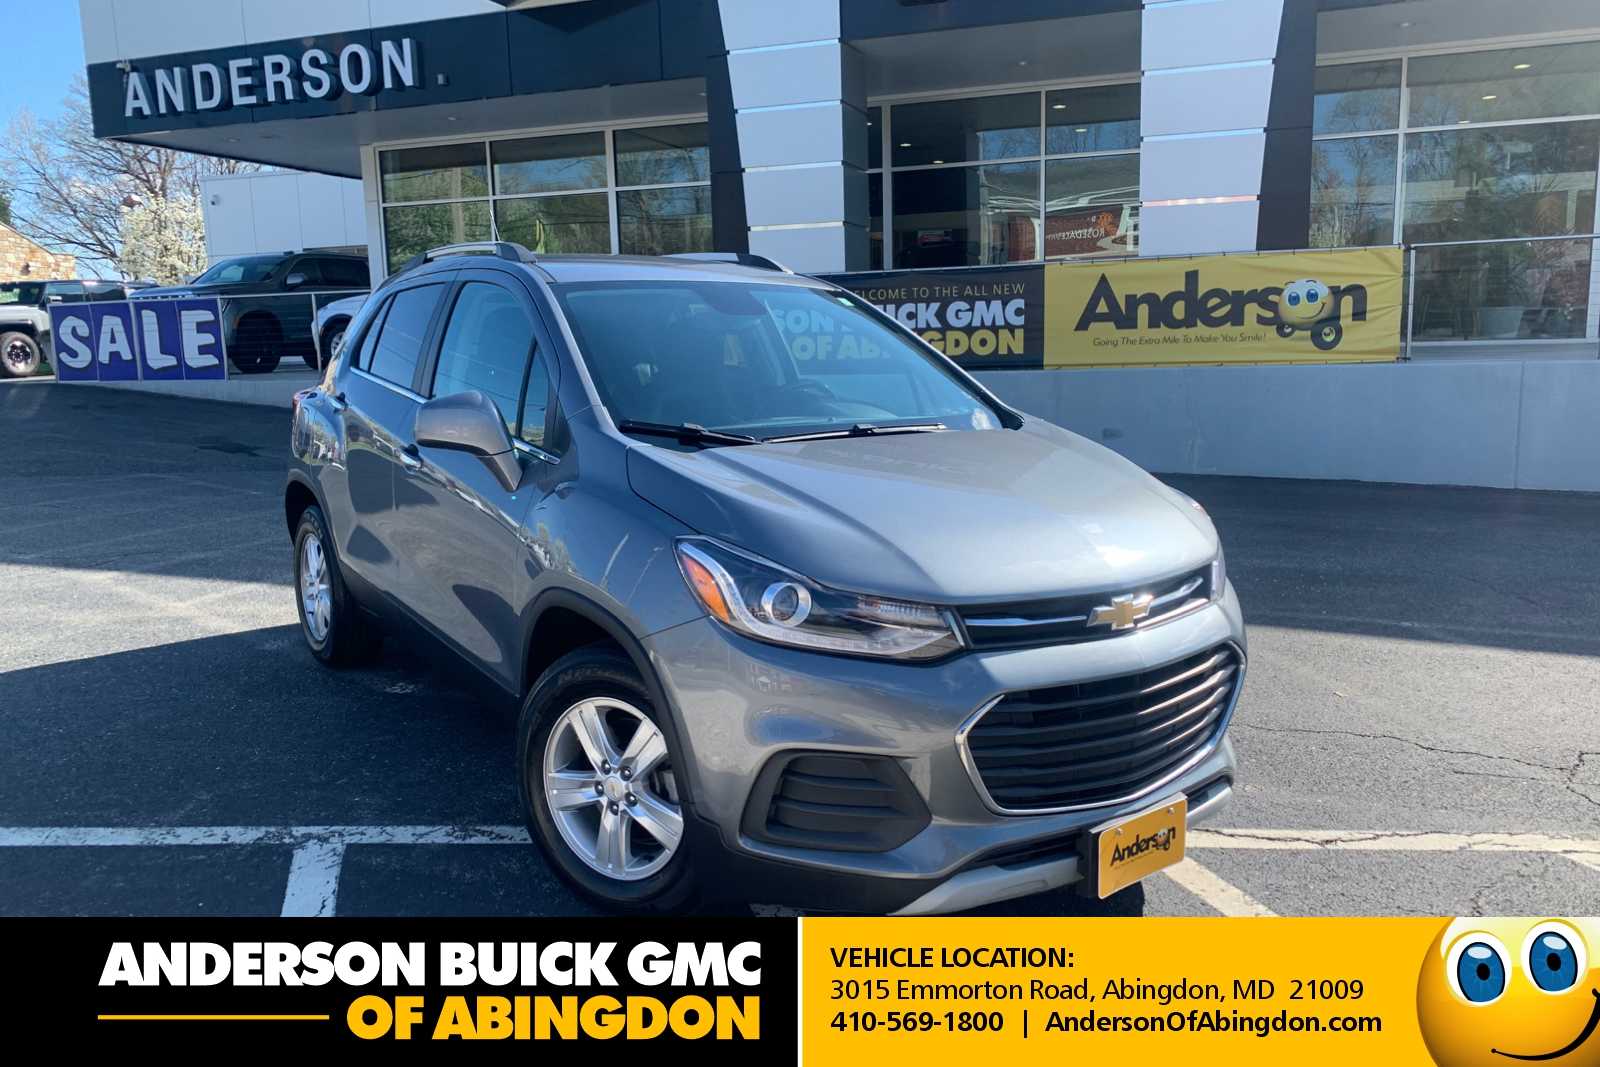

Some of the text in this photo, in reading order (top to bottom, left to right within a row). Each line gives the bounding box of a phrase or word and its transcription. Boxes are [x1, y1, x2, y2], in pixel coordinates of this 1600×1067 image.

[124, 38, 418, 118] ANDERSON
[912, 287, 929, 299] TO
[935, 286, 961, 298] THE
[963, 283, 989, 297] ALL
[992, 280, 1025, 296] NEW
[946, 298, 1025, 328] GMC
[58, 308, 220, 371] SALE
[791, 335, 833, 360] OF
[1092, 336, 1119, 348] Going
[1121, 335, 1137, 345] The
[1138, 335, 1161, 345] Extra
[1162, 334, 1180, 345] Mile
[1183, 333, 1192, 344] To
[1194, 333, 1219, 344] Make
[1221, 332, 1238, 343] You
